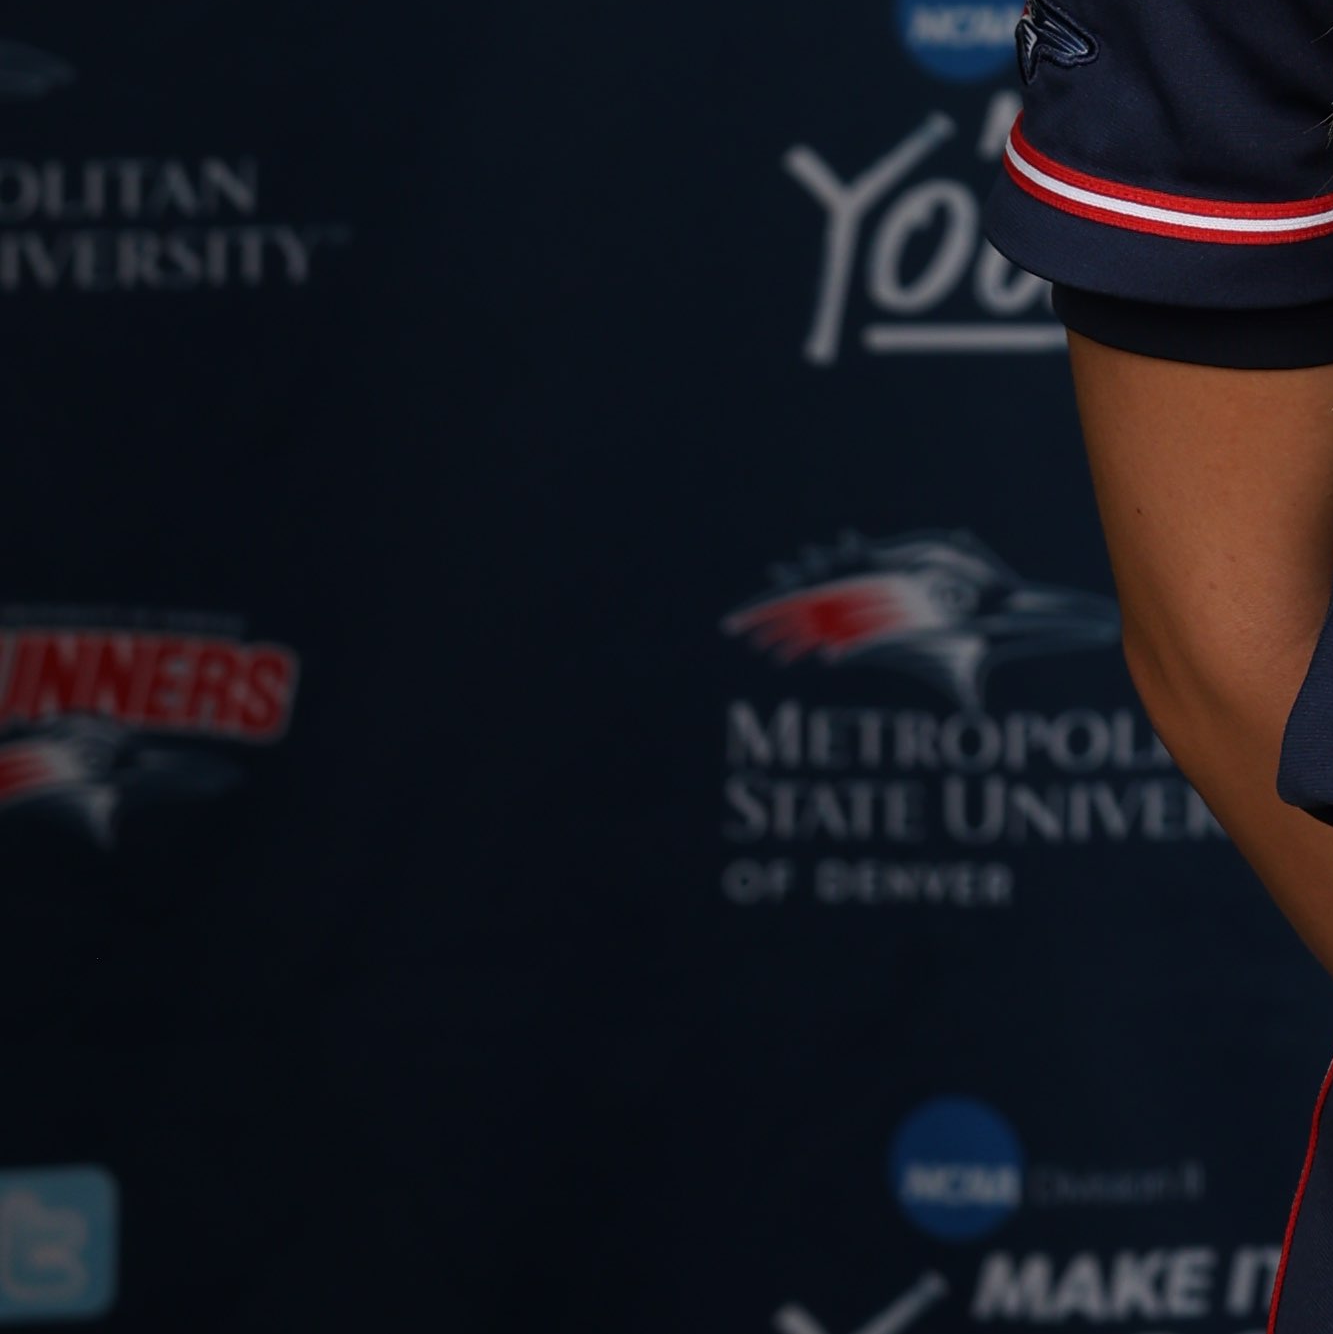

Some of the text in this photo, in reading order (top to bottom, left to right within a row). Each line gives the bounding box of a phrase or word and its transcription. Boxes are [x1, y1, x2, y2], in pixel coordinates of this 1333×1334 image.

[723, 771, 927, 843] STATE
[722, 859, 1014, 905] OF DENVER
[969, 1244, 1219, 1323] MAKE
